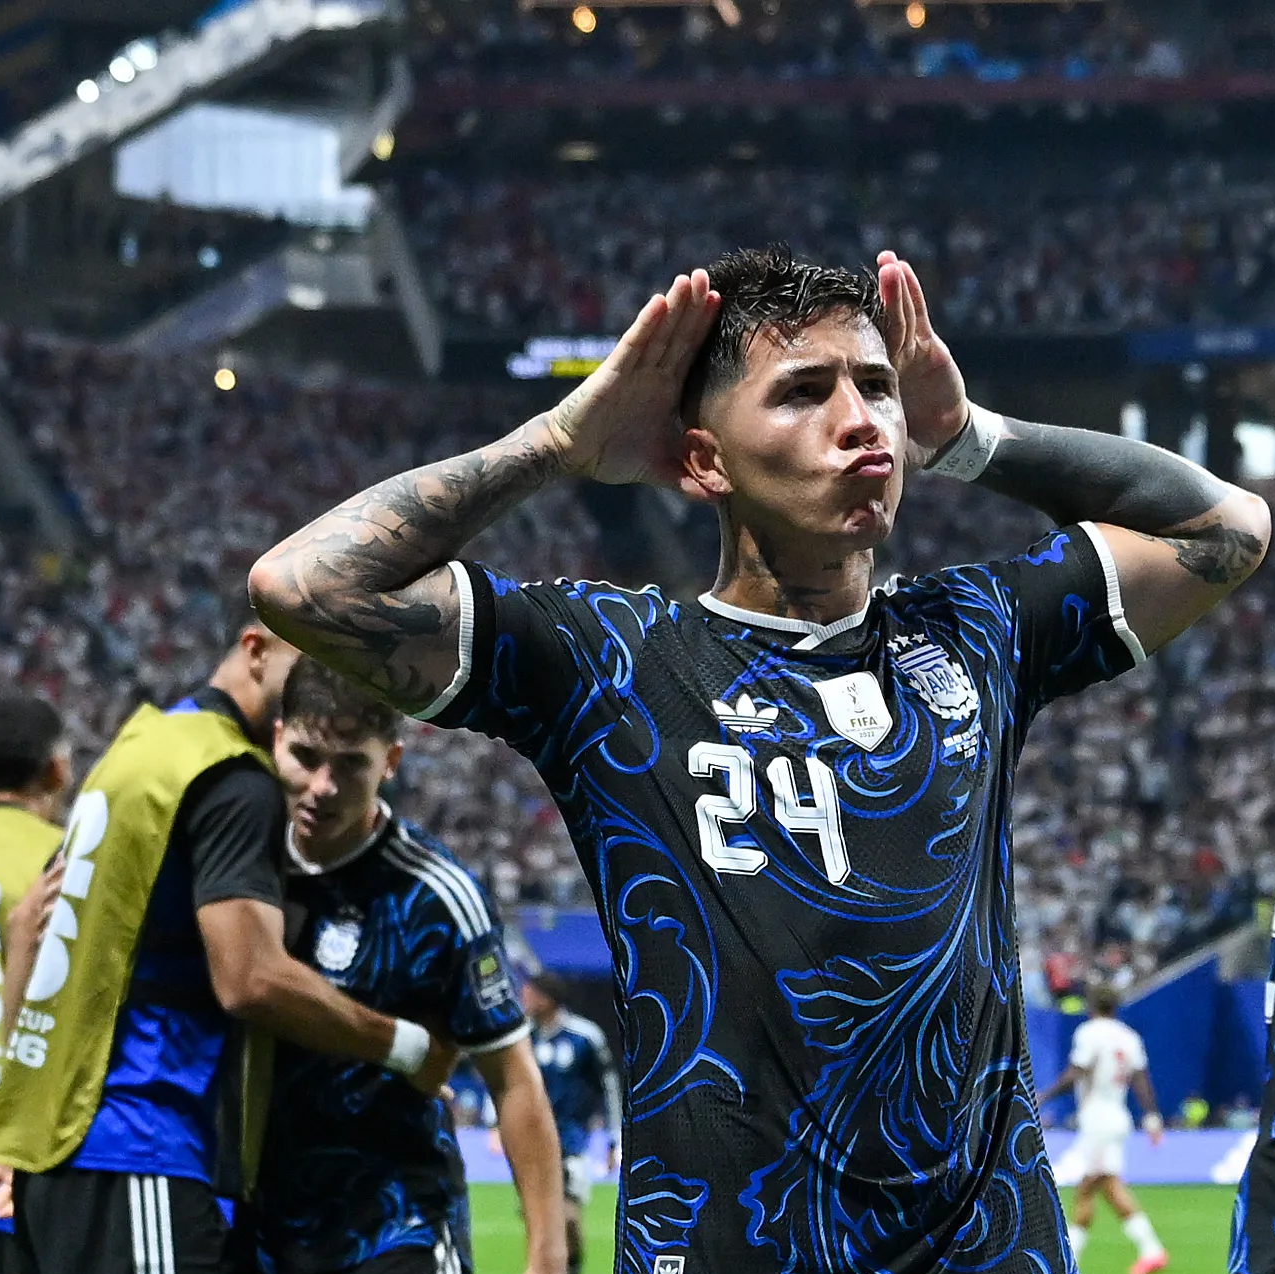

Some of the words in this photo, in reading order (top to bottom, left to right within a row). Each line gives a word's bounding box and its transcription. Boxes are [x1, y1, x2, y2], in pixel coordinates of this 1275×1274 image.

[921, 663, 959, 695] AFA
[850, 716, 878, 728] FIFA
[688, 741, 851, 886] 24
